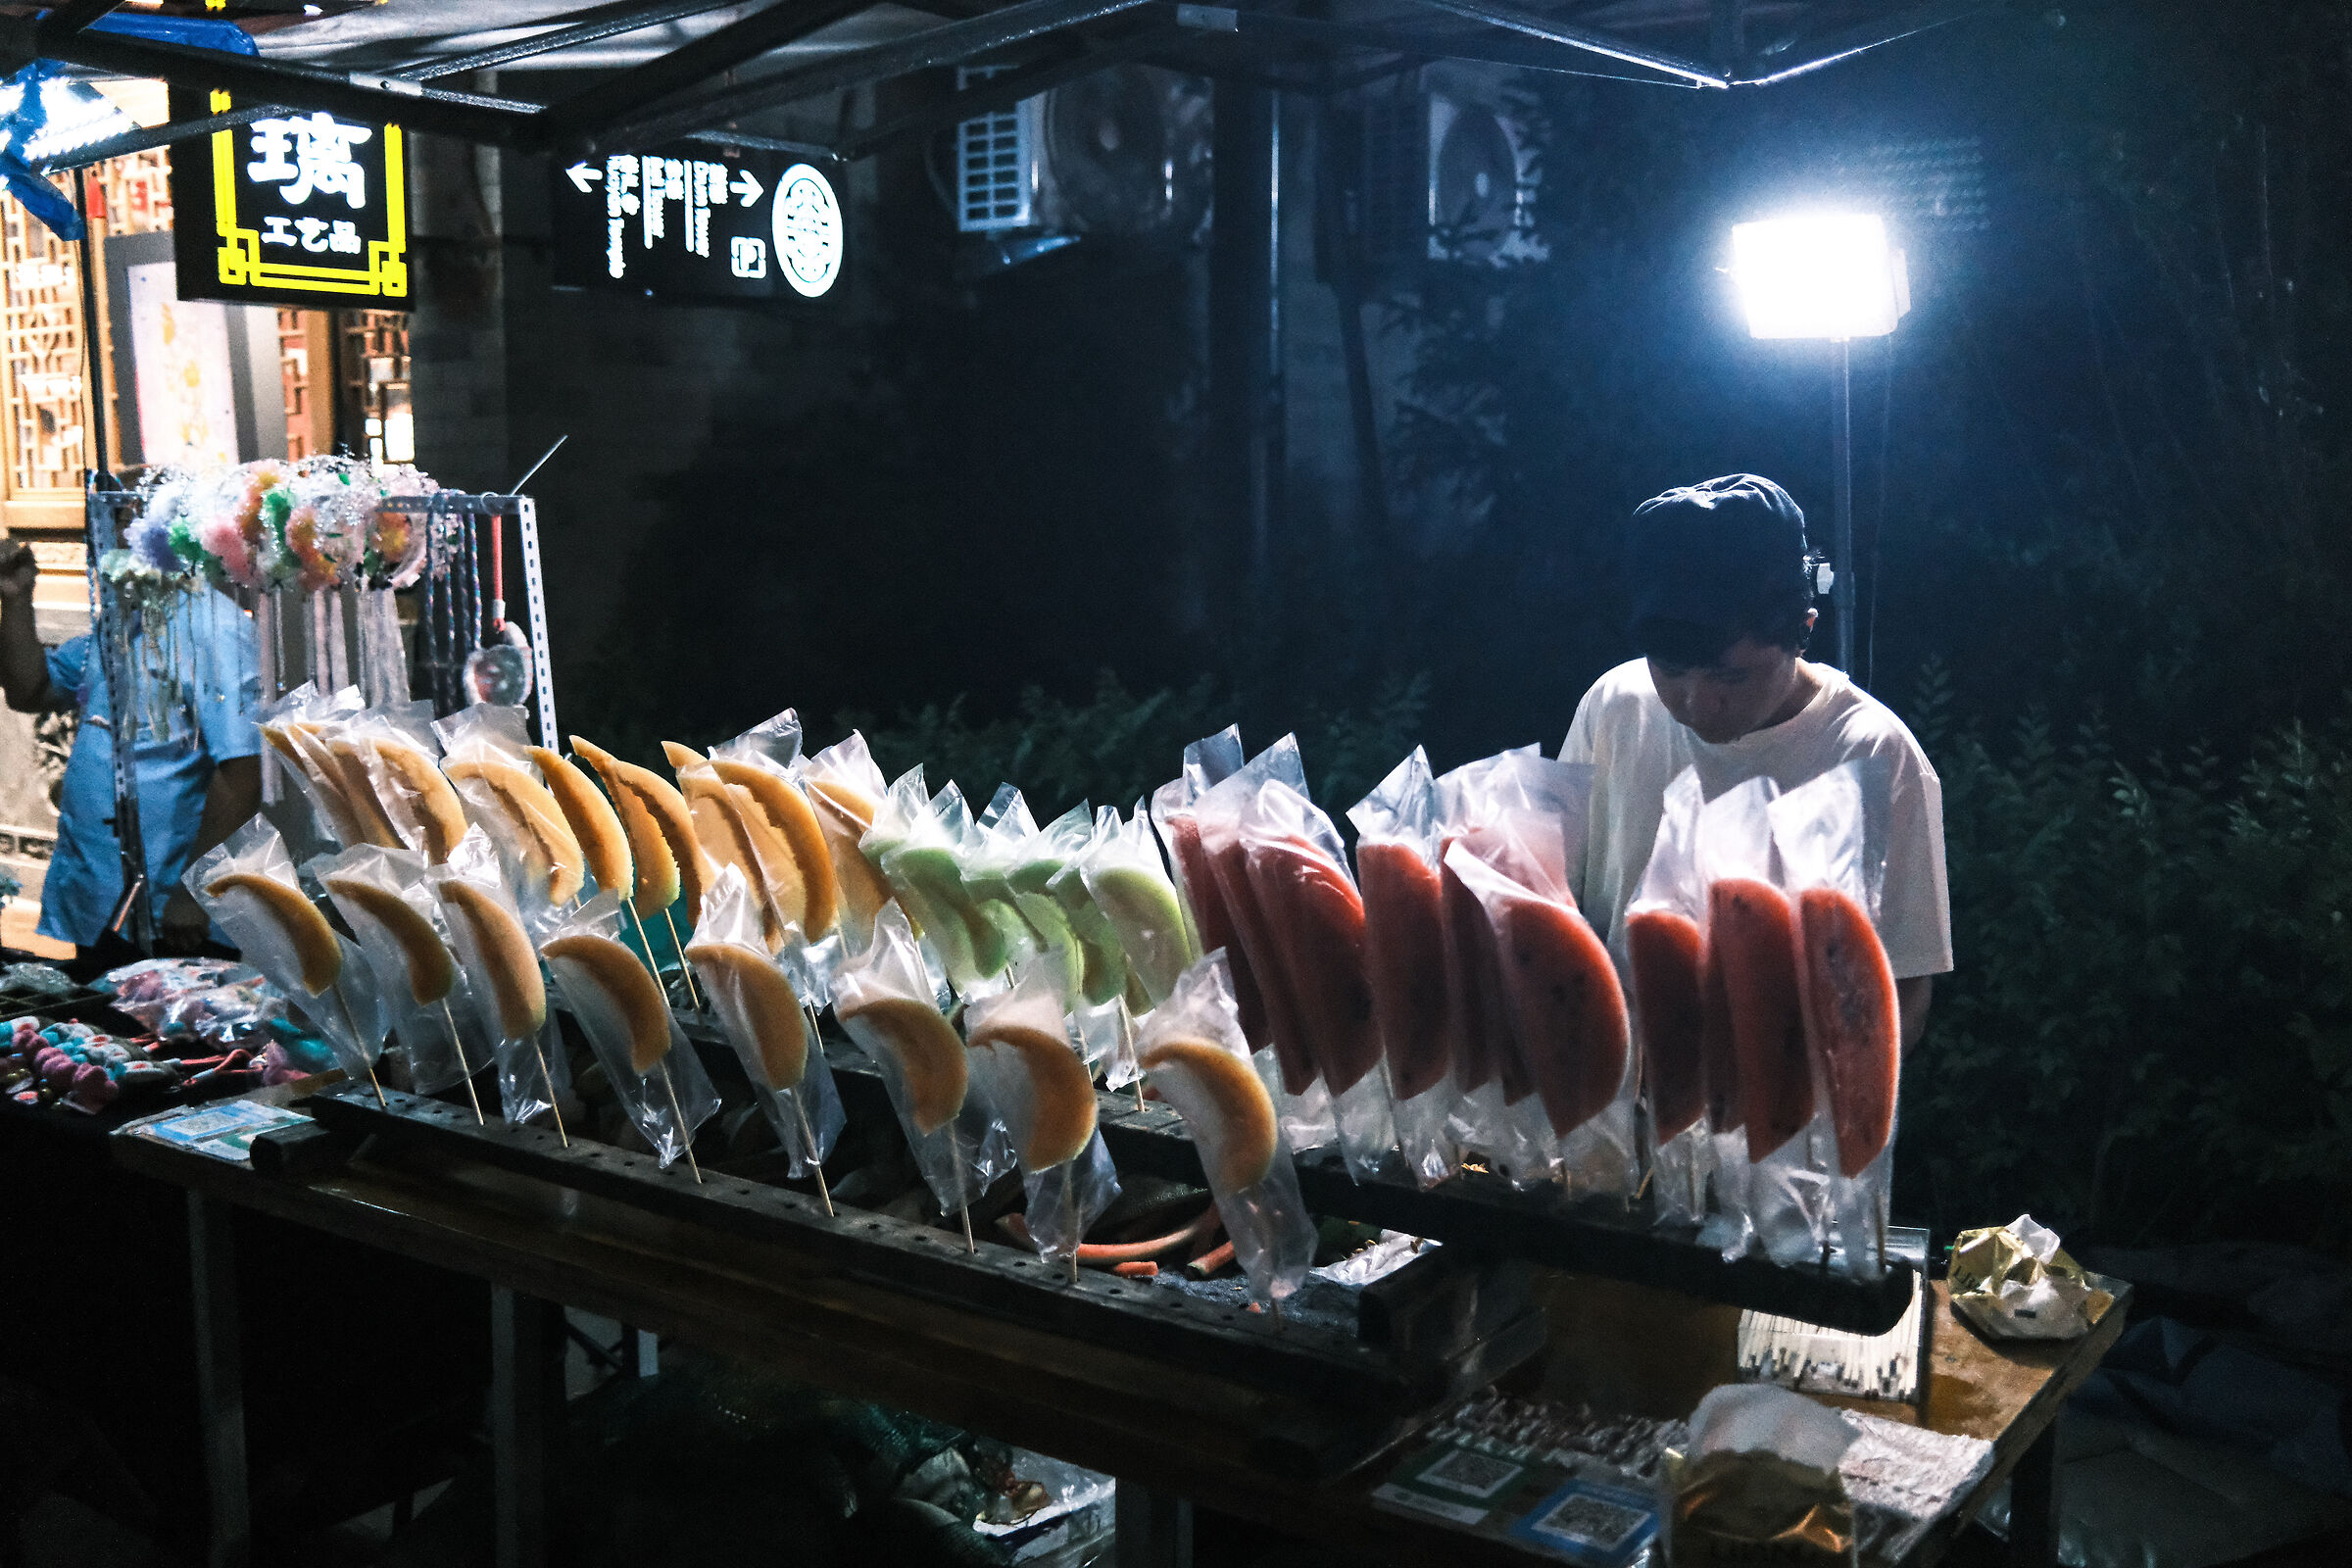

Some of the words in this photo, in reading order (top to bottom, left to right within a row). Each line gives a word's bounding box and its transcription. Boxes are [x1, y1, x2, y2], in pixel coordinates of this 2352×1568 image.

[247, 113, 372, 210] 璃
[261, 217, 362, 254] 工艺品
